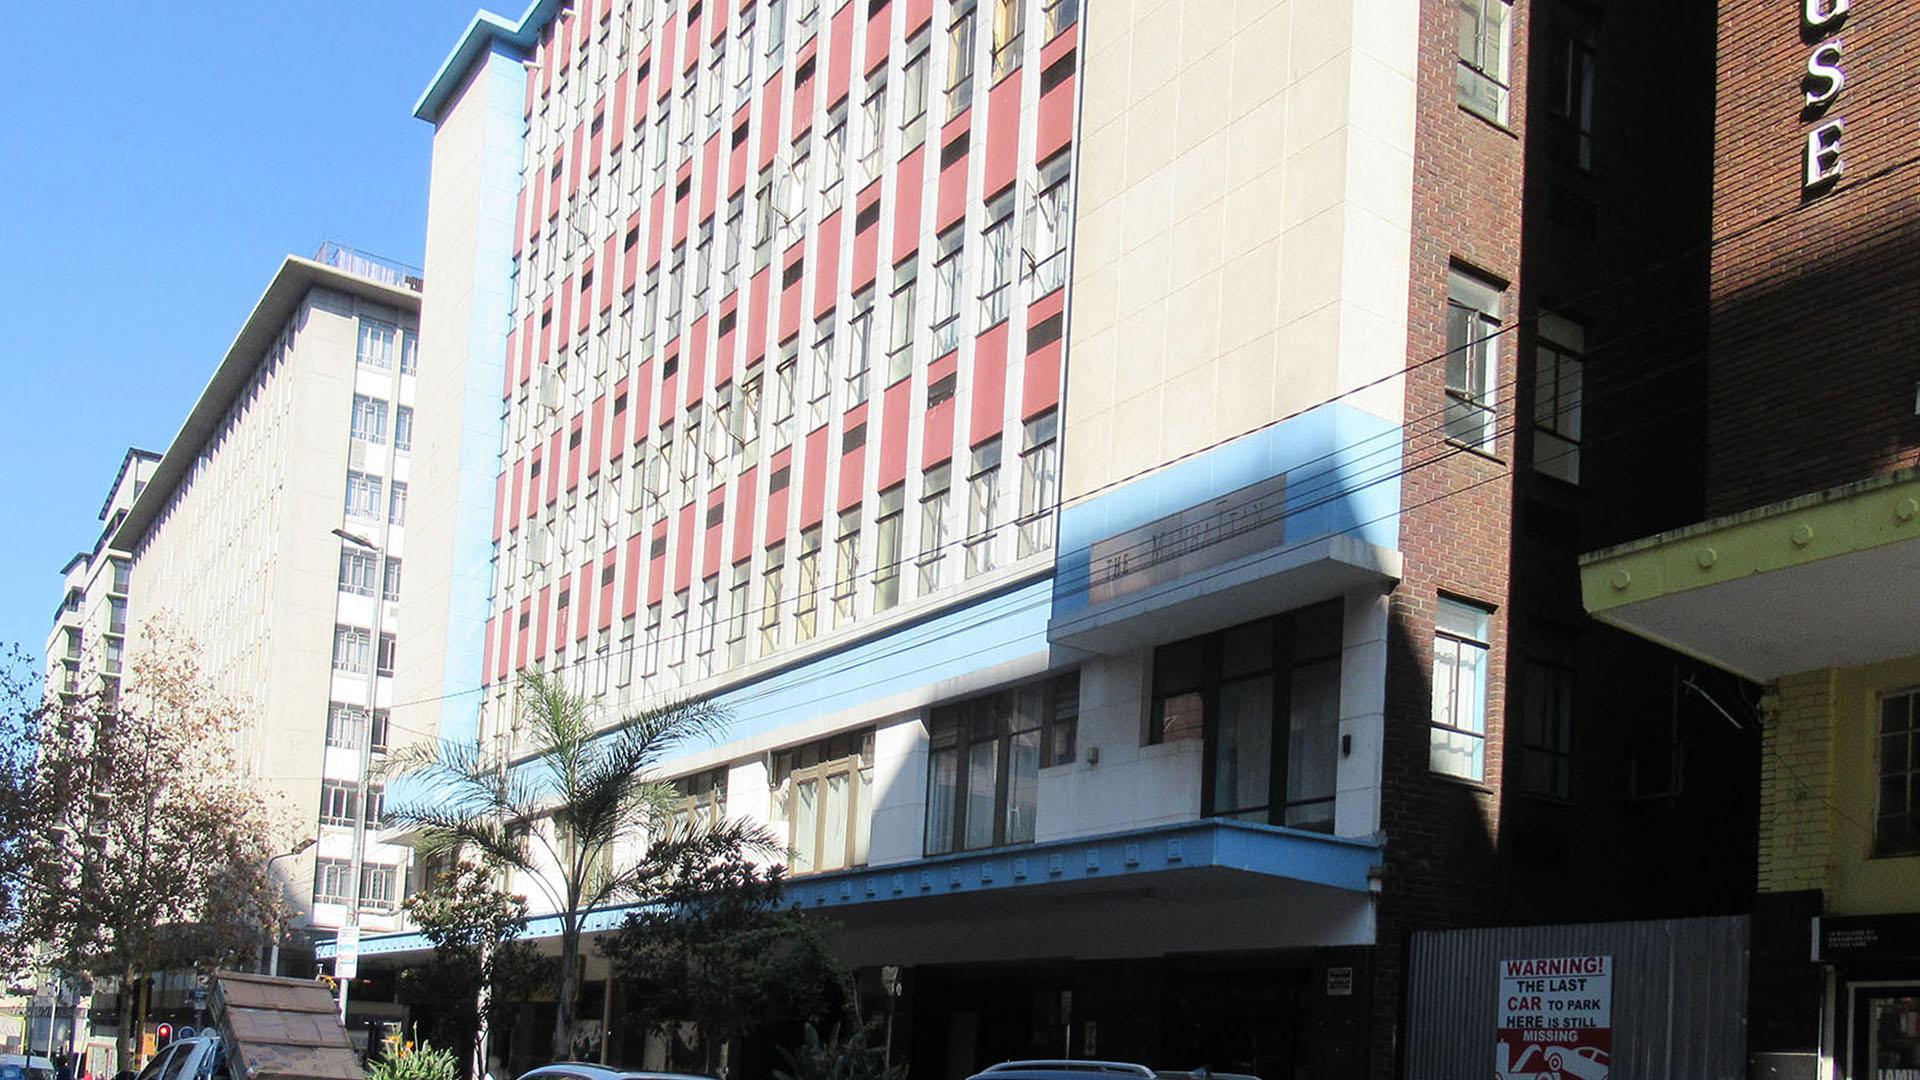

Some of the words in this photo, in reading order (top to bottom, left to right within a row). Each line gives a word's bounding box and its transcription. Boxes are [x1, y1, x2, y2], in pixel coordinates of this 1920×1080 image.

[1106, 553, 1129, 580] THE
[1506, 957, 1604, 977] WARNING!
[1517, 979, 1545, 993] THE
[1550, 978, 1587, 992] LAST
[1507, 996, 1542, 1012] CAR
[1548, 999, 1564, 1011] TO
[1567, 999, 1600, 1011] PARK
[1506, 1015, 1543, 1028] HERE
[1548, 1017, 1560, 1028] IS
[1562, 1016, 1597, 1028] STILL
[1523, 1029, 1578, 1042] MISSING
